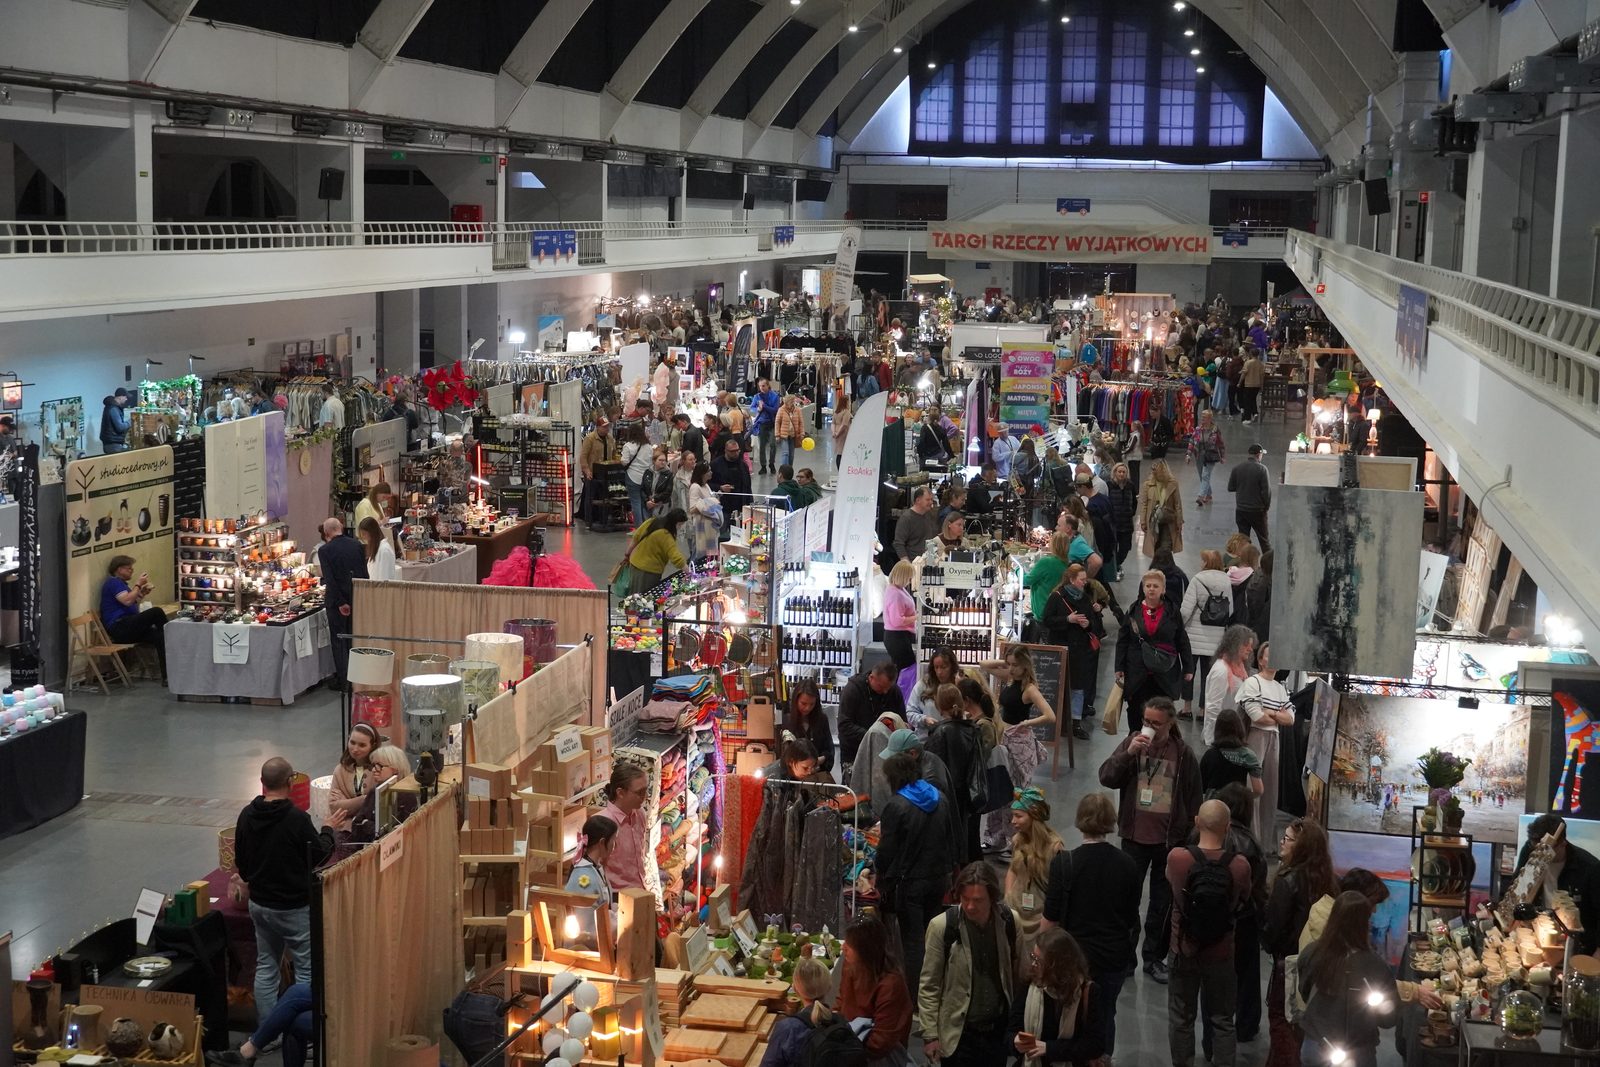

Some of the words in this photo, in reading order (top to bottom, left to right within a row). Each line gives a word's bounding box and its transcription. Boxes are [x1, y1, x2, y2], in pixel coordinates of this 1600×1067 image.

[932, 232, 986, 249] TARGI
[992, 234, 1059, 251] RZECZY
[1065, 235, 1207, 255] WYJĄTKOWYCH
[100, 456, 168, 480] studiocedrowy.pl
[949, 567, 972, 576] Oxymel
[85, 986, 137, 1001] TECHNIKA
[144, 991, 191, 1006] OBWARA
